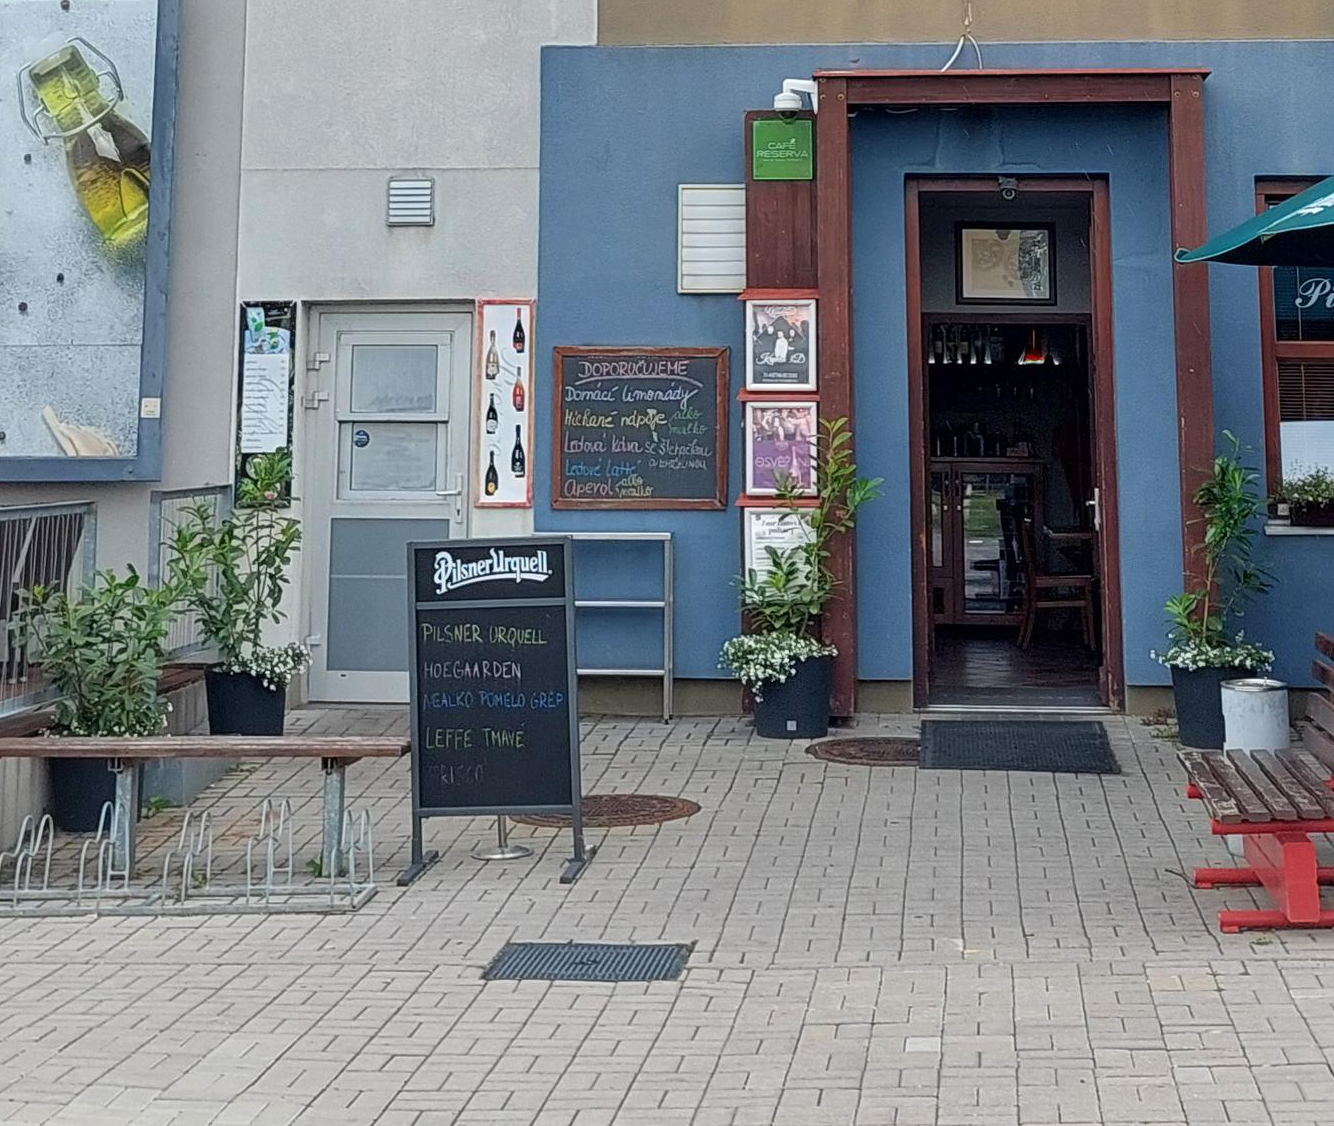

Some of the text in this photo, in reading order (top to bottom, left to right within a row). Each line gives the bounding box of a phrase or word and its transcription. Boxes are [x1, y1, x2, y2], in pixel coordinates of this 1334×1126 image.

[756, 150, 809, 158] RESERVA
[578, 359, 690, 377] DOPORUČUJEME
[564, 382, 698, 409] Domácí limonády
[434, 548, 549, 594] Pilsner Urquell
[422, 623, 547, 647] PILSNER URQUELL
[424, 660, 522, 680] HOEGAARDEN
[478, 690, 526, 708] POMELO
[426, 727, 473, 750] LEFFE
